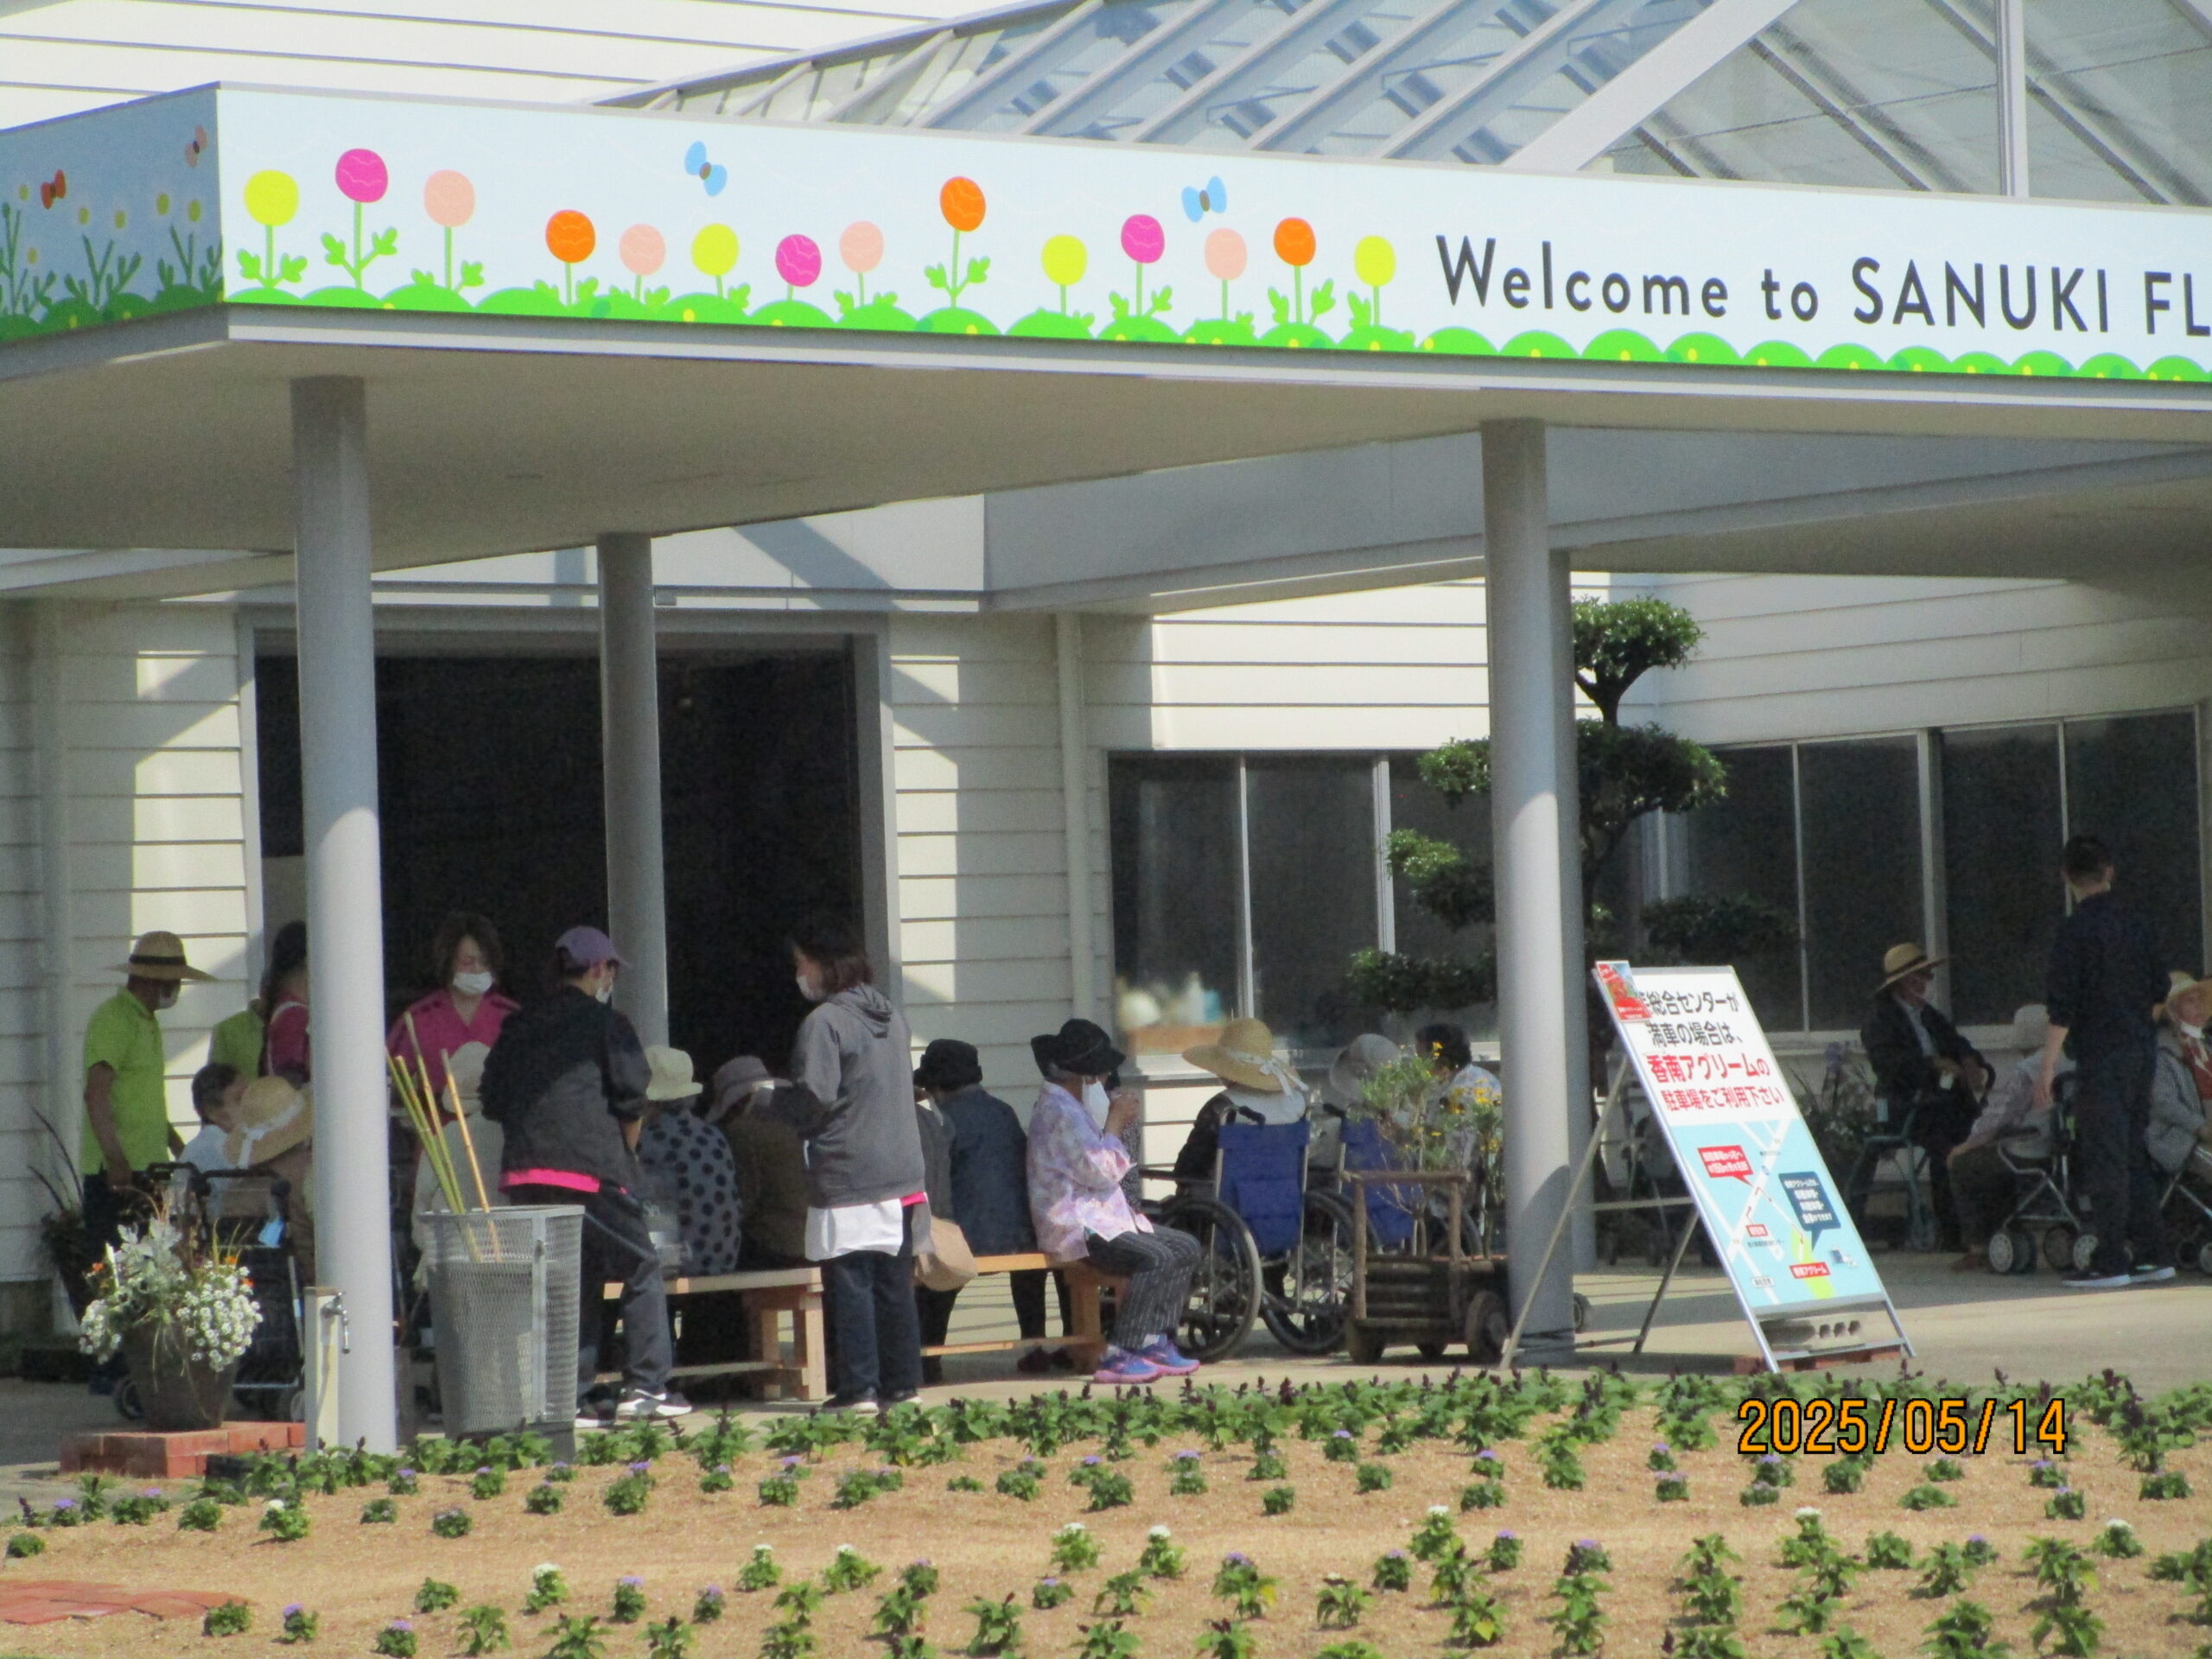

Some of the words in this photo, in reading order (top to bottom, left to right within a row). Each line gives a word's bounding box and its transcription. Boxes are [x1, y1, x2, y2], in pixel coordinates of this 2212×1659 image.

[1437, 235, 1728, 318] Welcome
[1761, 268, 1819, 321] to
[1852, 257, 2109, 334] SANUKI
[2144, 270, 2211, 336] FL
[1647, 1053, 1770, 1083] 香南アグリームの
[1662, 1087, 1783, 1111] 駐車場をご利用下さい
